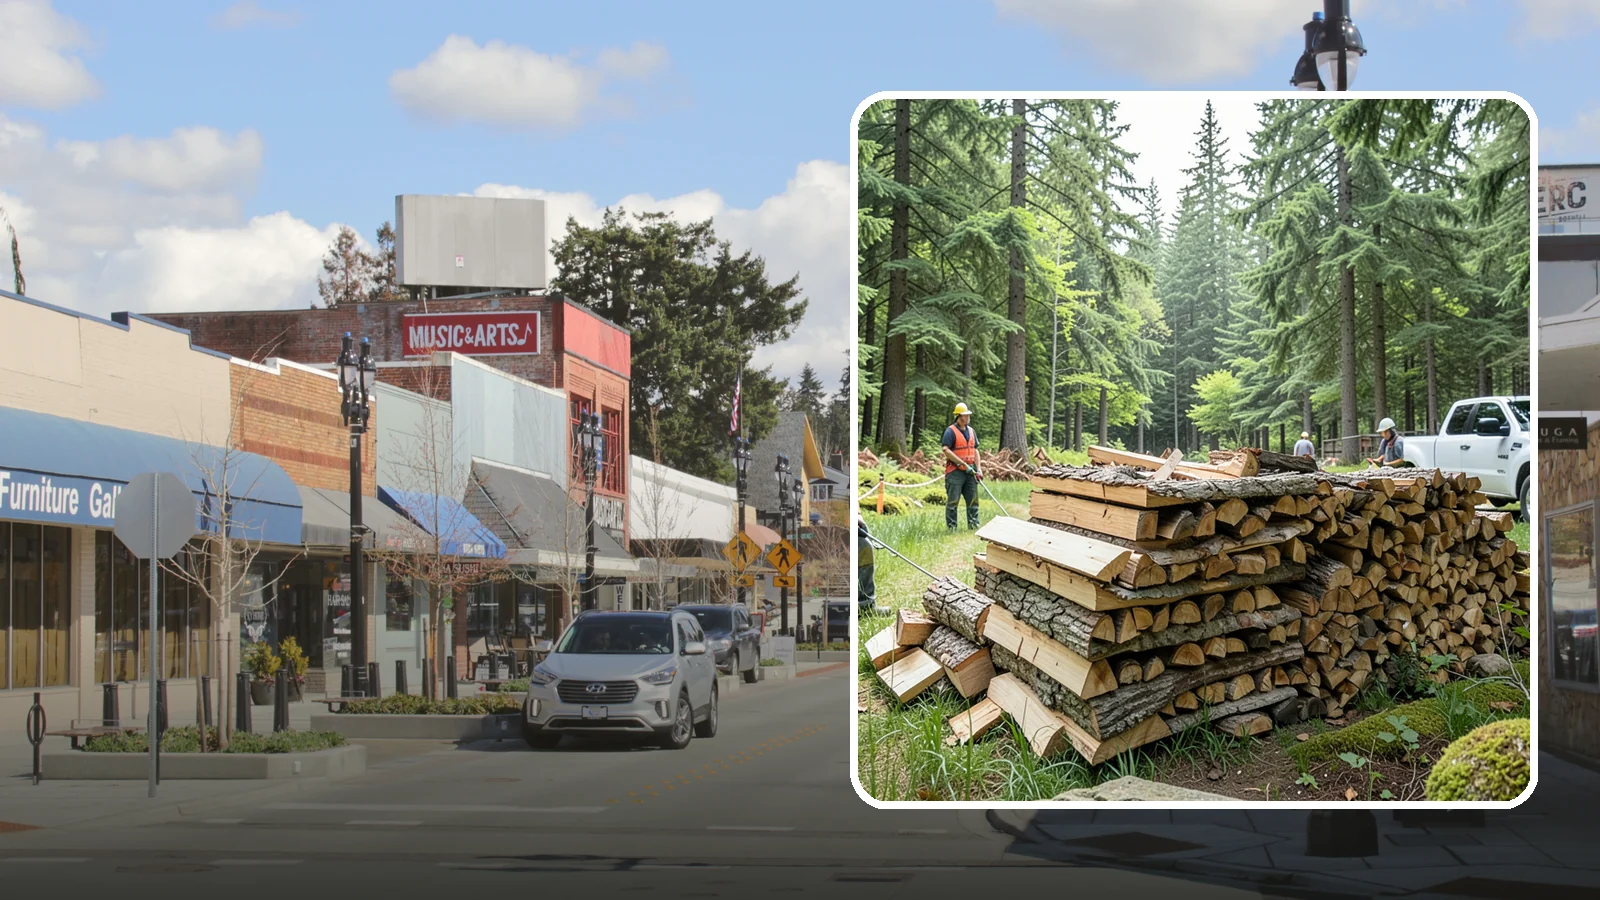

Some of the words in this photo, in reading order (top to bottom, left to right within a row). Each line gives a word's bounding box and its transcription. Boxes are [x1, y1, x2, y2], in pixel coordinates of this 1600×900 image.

[409, 323, 520, 348] MUSIC&ARTS
[1540, 427, 1577, 437] UGA
[0, 471, 79, 515] Furniture
[89, 482, 122, 519] Gal
[453, 563, 479, 574] SUSHI
